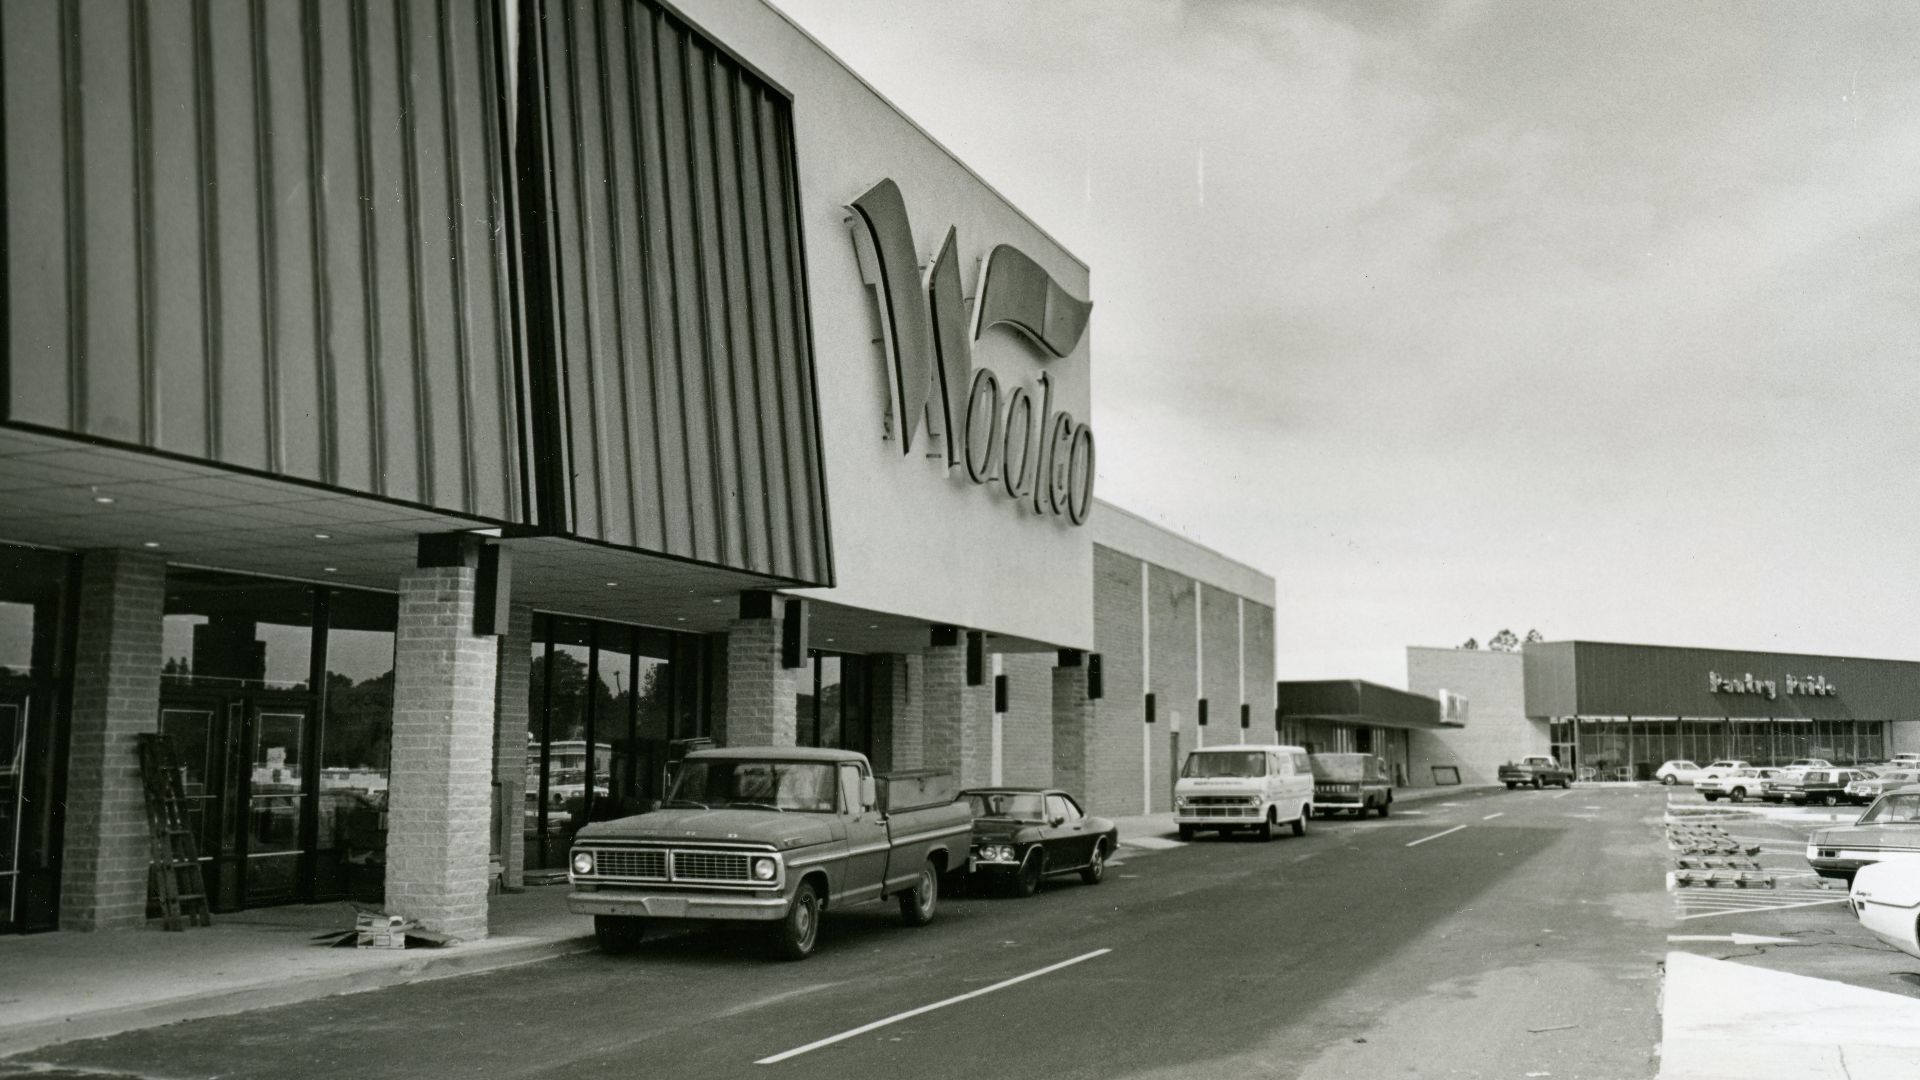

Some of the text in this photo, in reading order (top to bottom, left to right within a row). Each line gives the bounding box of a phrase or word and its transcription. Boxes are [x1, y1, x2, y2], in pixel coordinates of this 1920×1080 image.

[842, 178, 1096, 526] Woolco
[1709, 671, 1837, 700] Pantry Pride
